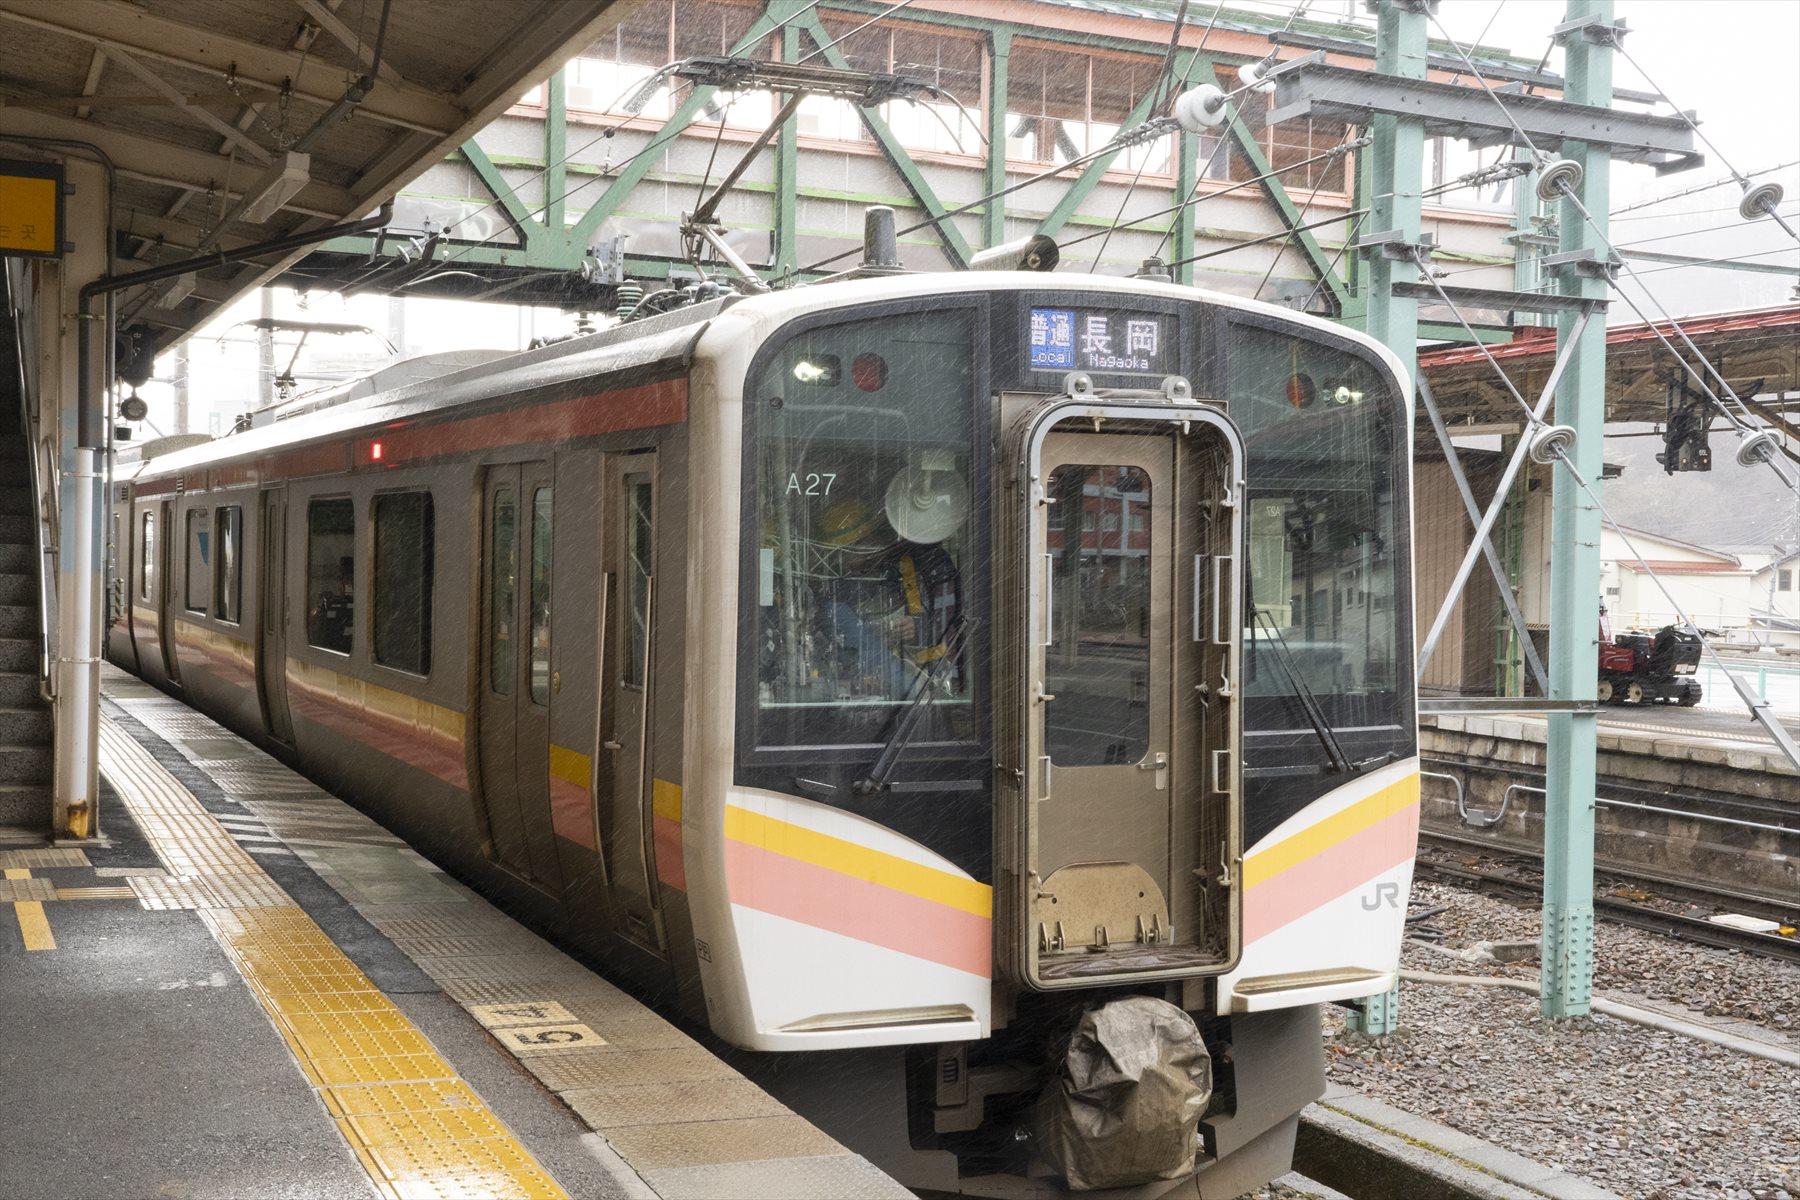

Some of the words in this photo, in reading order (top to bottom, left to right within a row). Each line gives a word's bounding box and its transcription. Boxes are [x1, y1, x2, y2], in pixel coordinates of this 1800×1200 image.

[1031, 313, 1071, 347] 普通
[1081, 316, 1158, 357] 長岡
[1089, 353, 1149, 369] Nagaoka
[785, 472, 837, 496] A27
[1361, 881, 1400, 911] JR
